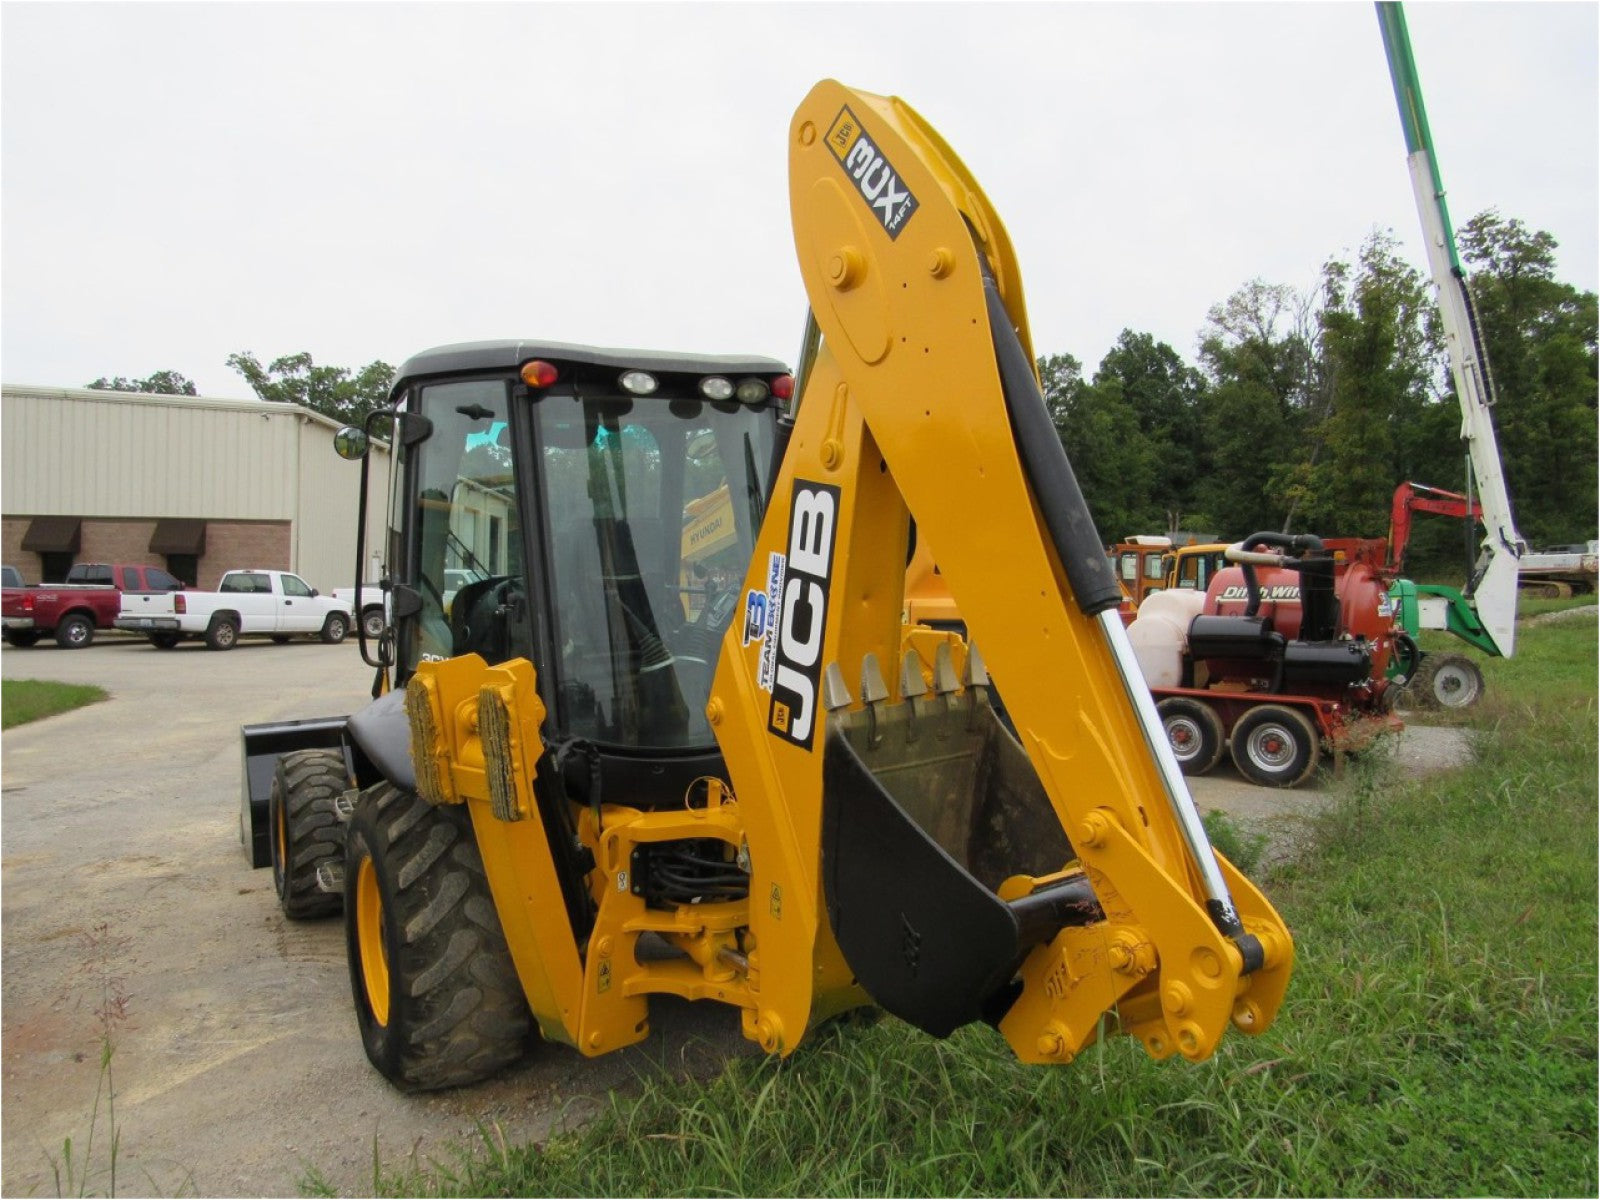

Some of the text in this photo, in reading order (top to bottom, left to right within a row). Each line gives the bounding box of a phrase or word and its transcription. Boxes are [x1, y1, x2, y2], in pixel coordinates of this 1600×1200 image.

[839, 122, 853, 147] JCB
[889, 197, 912, 230] 14FT
[690, 517, 722, 545] HYUNDAI
[1222, 585, 1269, 599] Dith
[777, 489, 835, 741] JCB
[761, 629, 773, 686] TEAM
